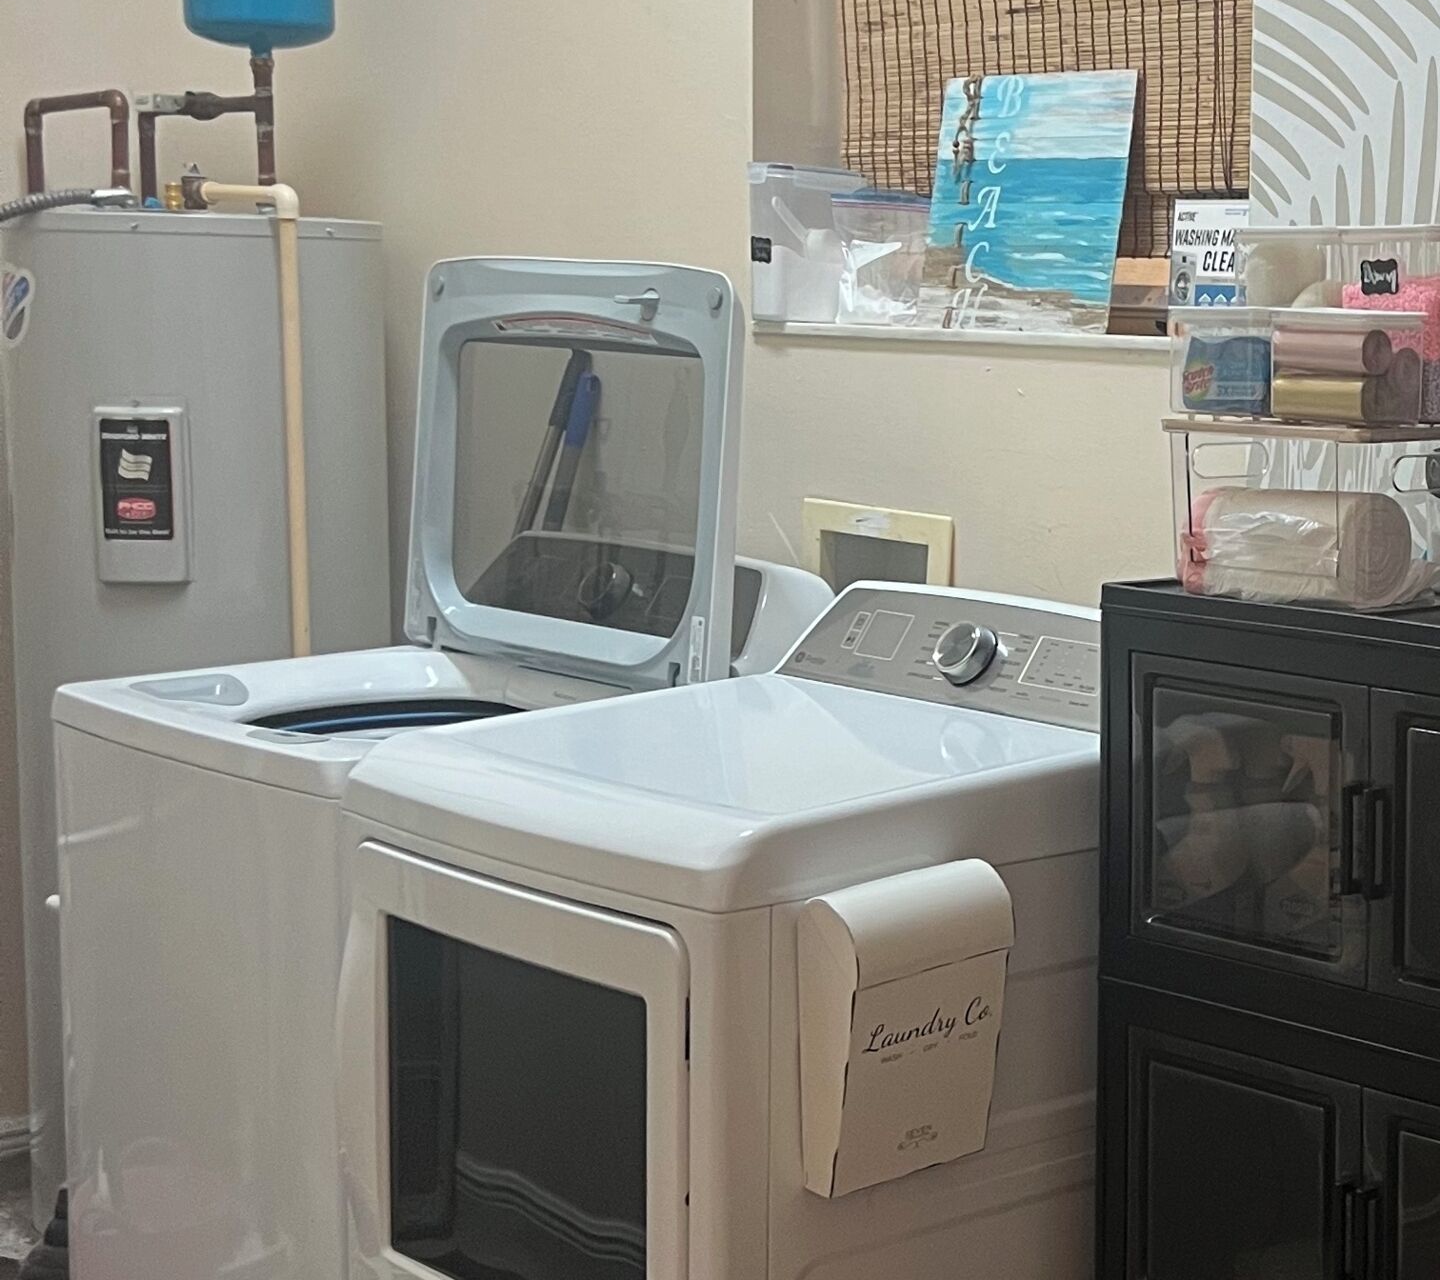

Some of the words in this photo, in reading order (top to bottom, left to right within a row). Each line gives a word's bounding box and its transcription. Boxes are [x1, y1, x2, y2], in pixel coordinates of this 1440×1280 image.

[1174, 228, 1220, 247] WASHING
[1202, 250, 1236, 273] CLEA
[861, 1007, 957, 1054] Laundry
